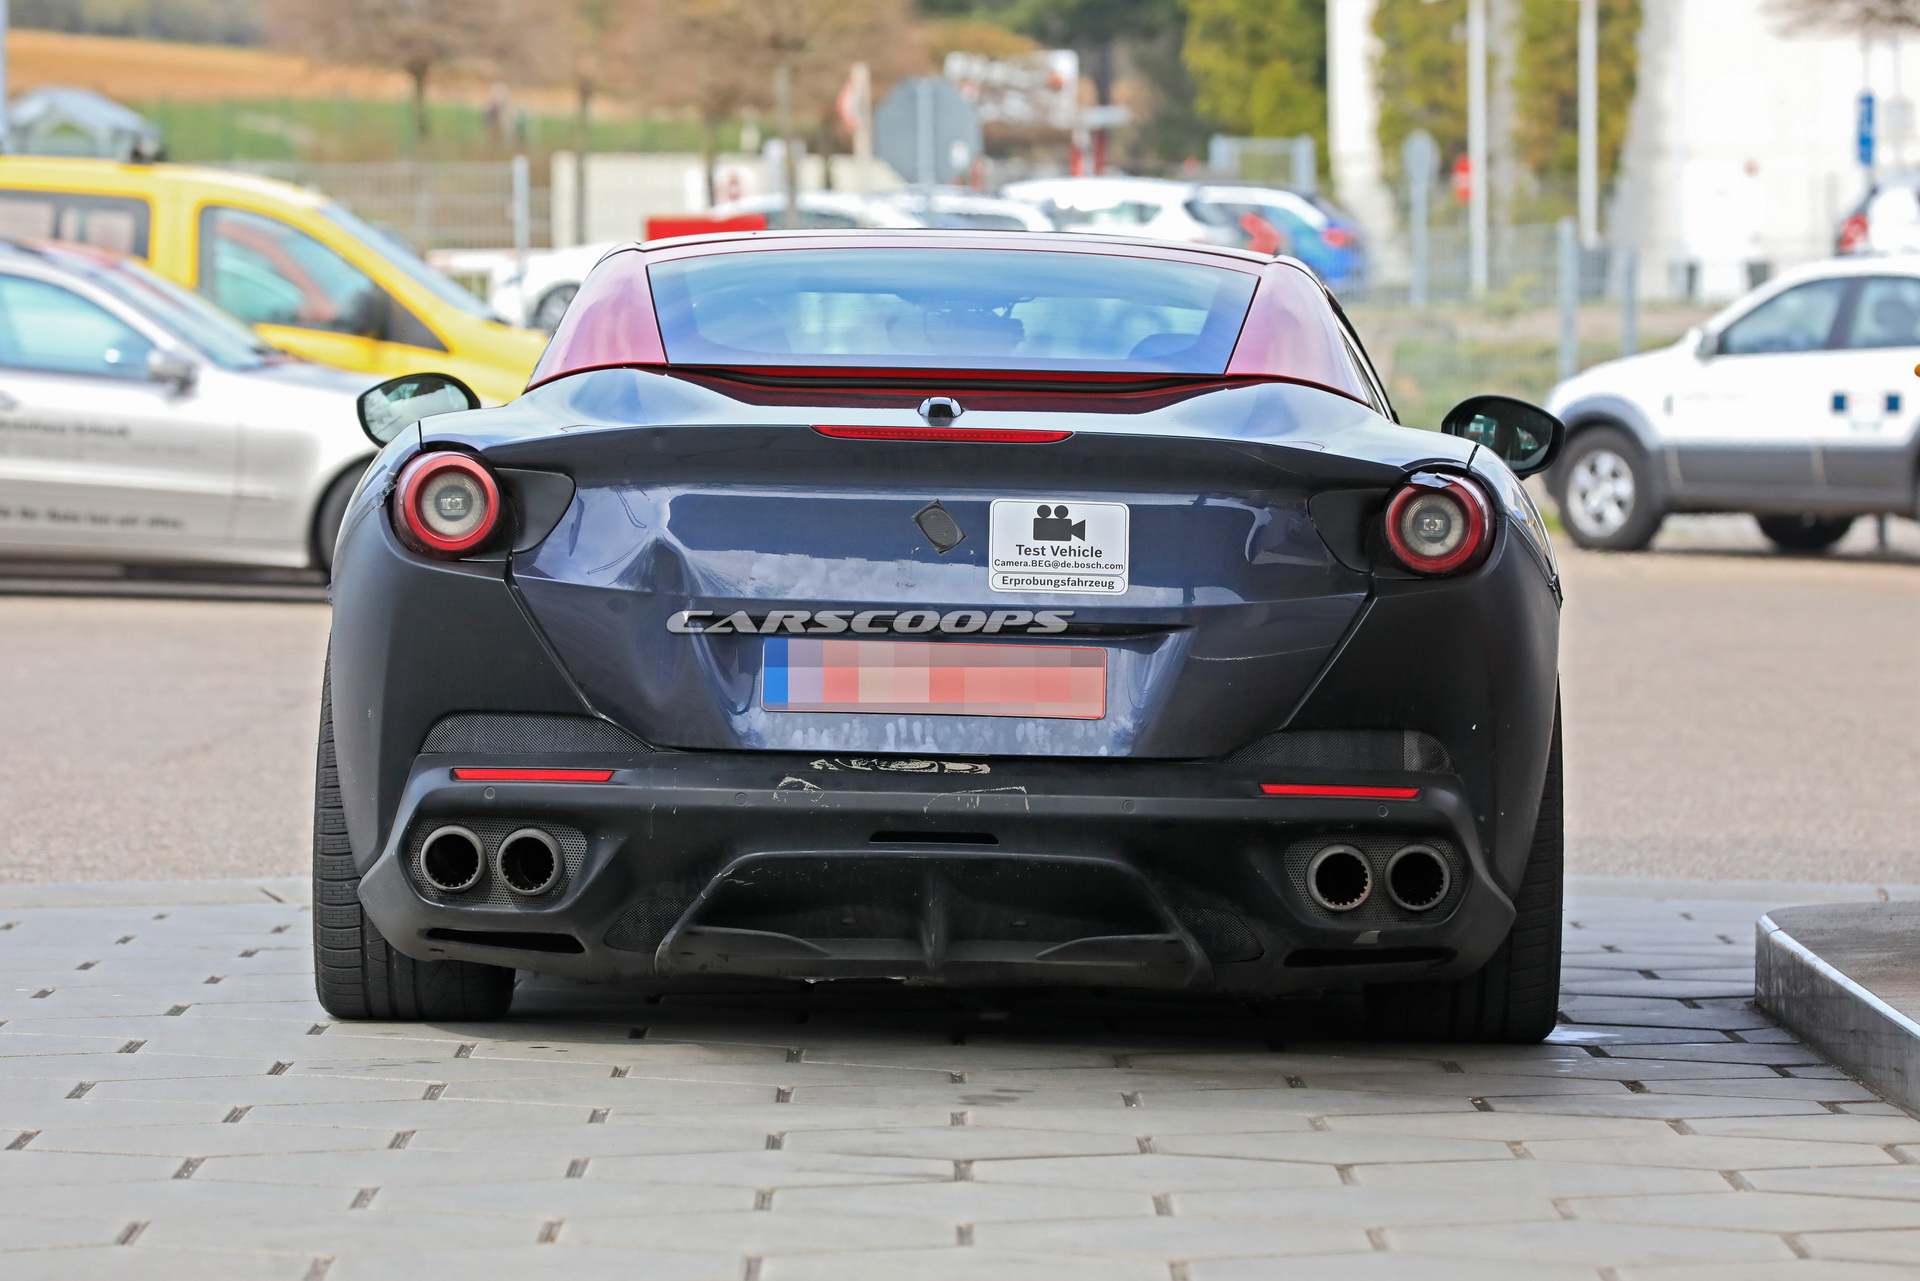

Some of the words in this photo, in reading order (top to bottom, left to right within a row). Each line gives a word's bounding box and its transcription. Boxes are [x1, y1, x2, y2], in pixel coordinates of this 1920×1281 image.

[1015, 544, 1047, 557] Test
[1050, 545, 1103, 558] Vehicle
[994, 558, 1124, 570] Camera.BEG@de.bosch.com
[1002, 575, 1115, 590] Erprobungsfahrzeug
